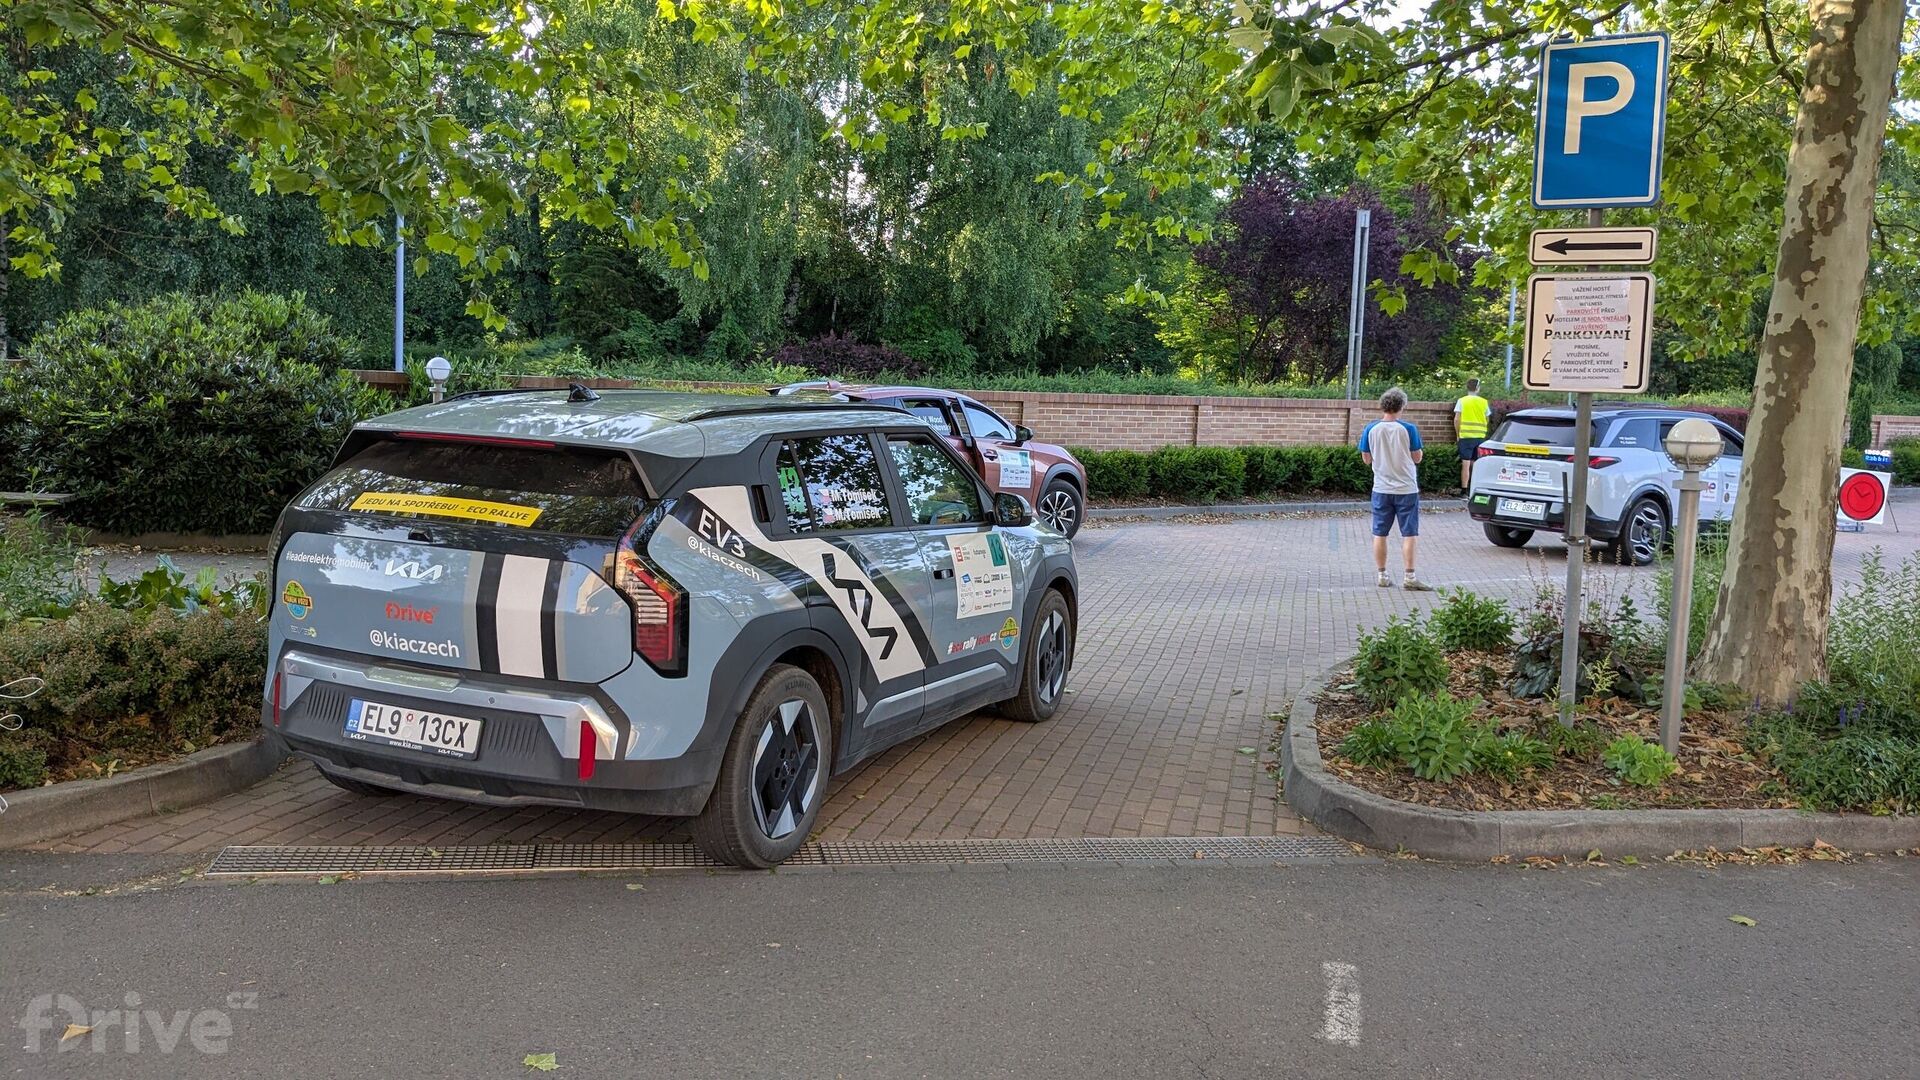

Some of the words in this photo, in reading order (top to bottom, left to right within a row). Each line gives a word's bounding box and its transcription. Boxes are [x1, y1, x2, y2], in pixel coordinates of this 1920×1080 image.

[1563, 61, 1635, 154] P
[386, 498, 401, 506] NA
[402, 499, 460, 511] SPOTŘEBU!
[466, 505, 488, 514] ECO
[488, 508, 530, 520] RALLYE
[698, 508, 746, 558] EV3
[286, 552, 374, 571] #leaderelektromobility
[687, 536, 761, 582] @kiaczech
[369, 629, 461, 658] @kiaczech
[348, 719, 360, 729] CZ
[362, 704, 402, 736] EL9
[418, 714, 470, 749] 13CX
